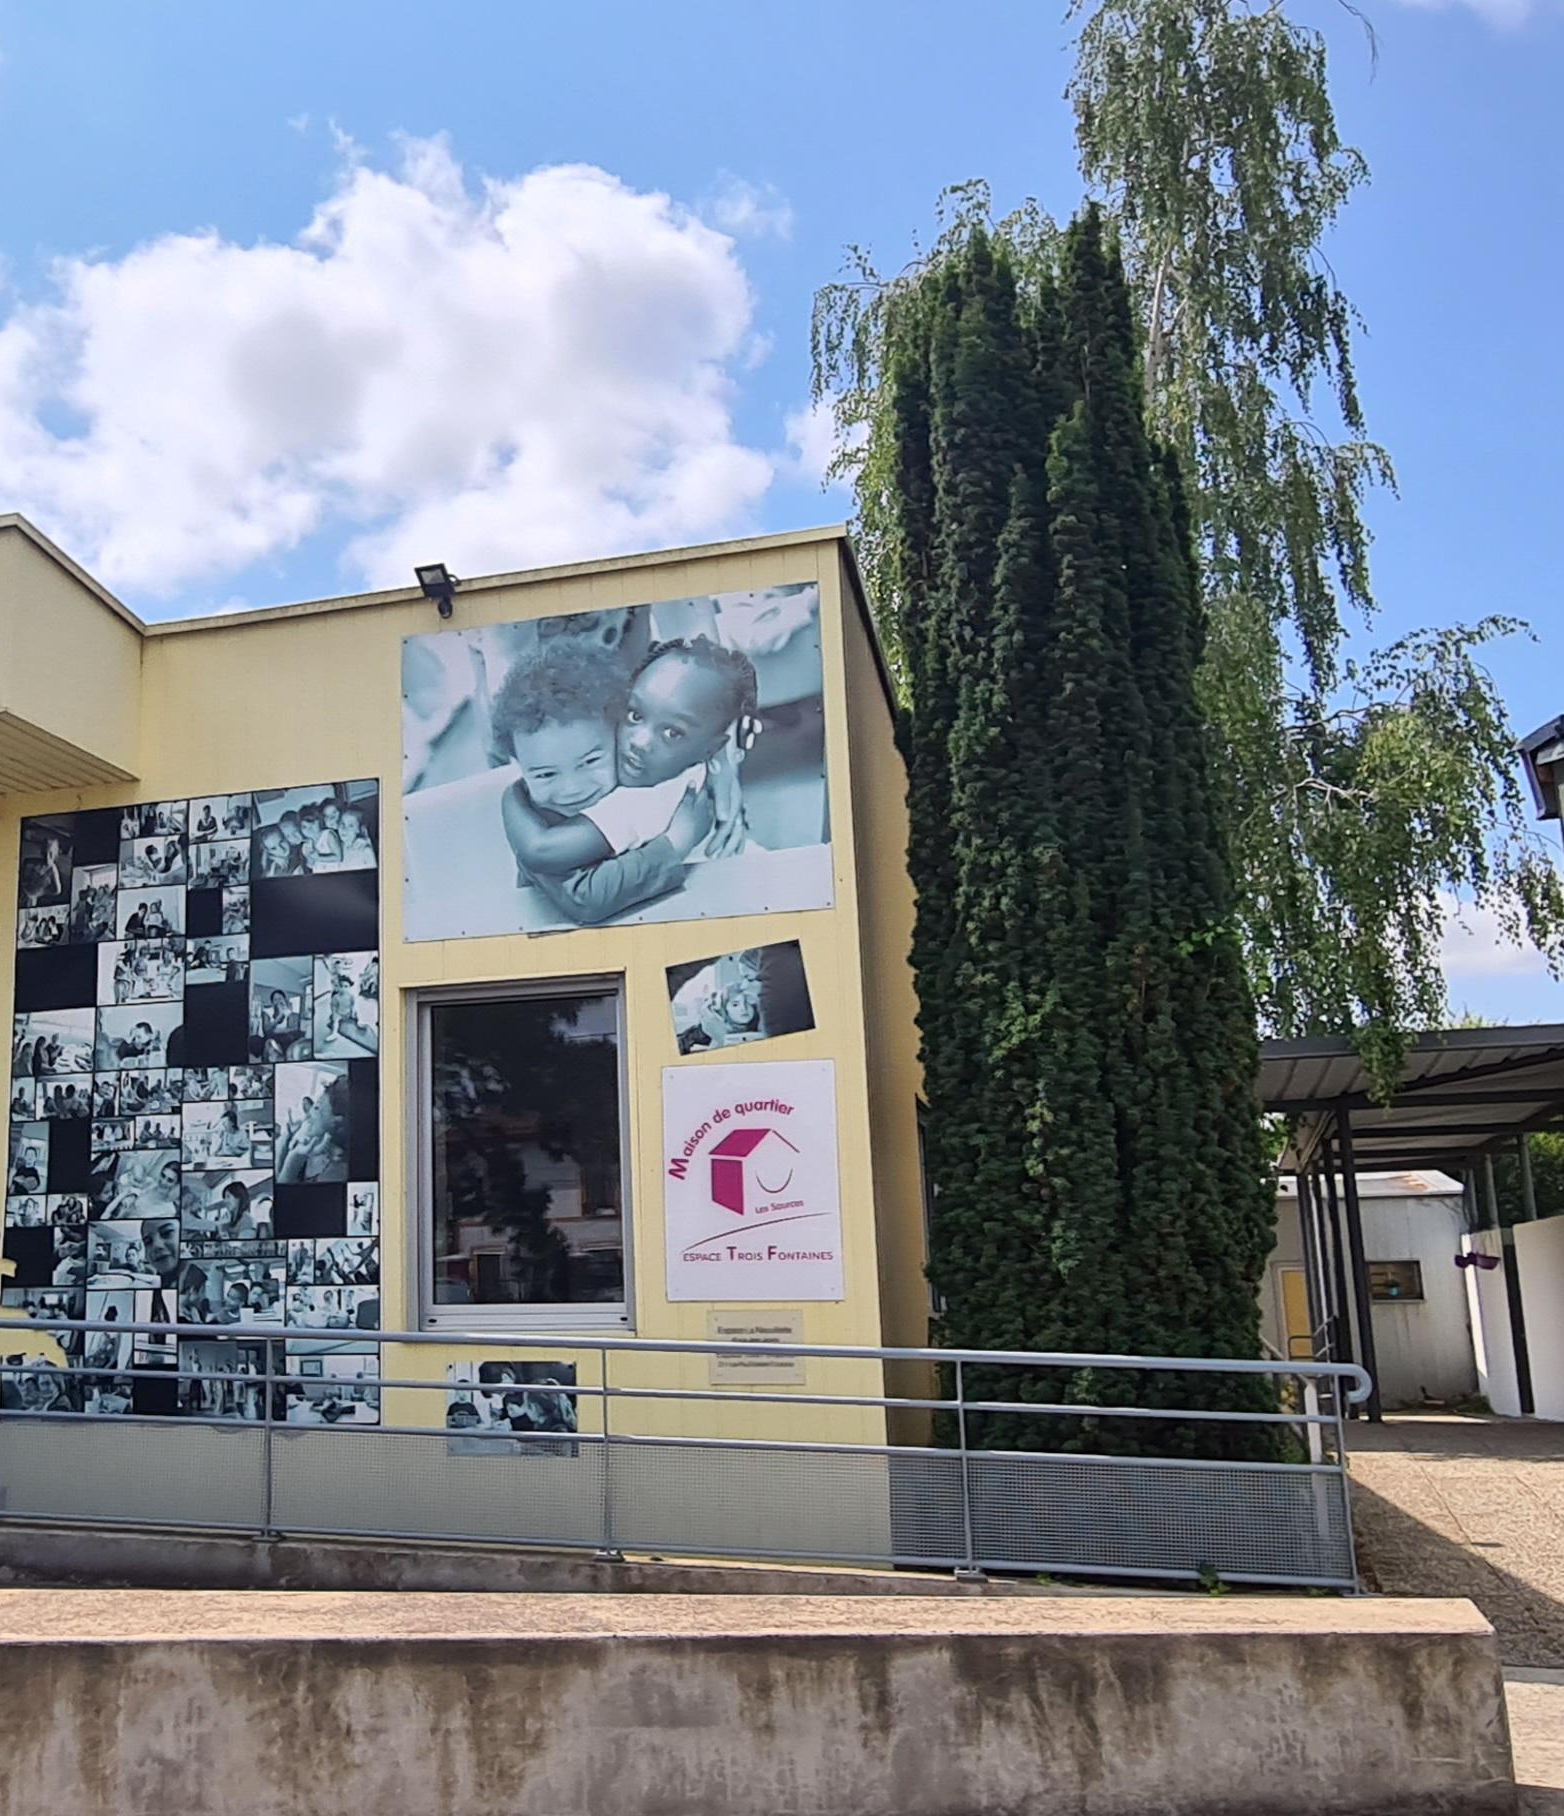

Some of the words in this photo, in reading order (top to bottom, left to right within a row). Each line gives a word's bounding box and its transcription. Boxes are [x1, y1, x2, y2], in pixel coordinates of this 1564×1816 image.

[668, 1122, 712, 1180] Maison
[712, 1109, 731, 1123] de
[734, 1099, 794, 1116] quartier
[755, 1206, 769, 1214] Les
[771, 1200, 804, 1211] Sources
[683, 1253, 722, 1262] ESPACE
[726, 1246, 763, 1261] TROIS
[768, 1245, 833, 1261] FONTAINES
